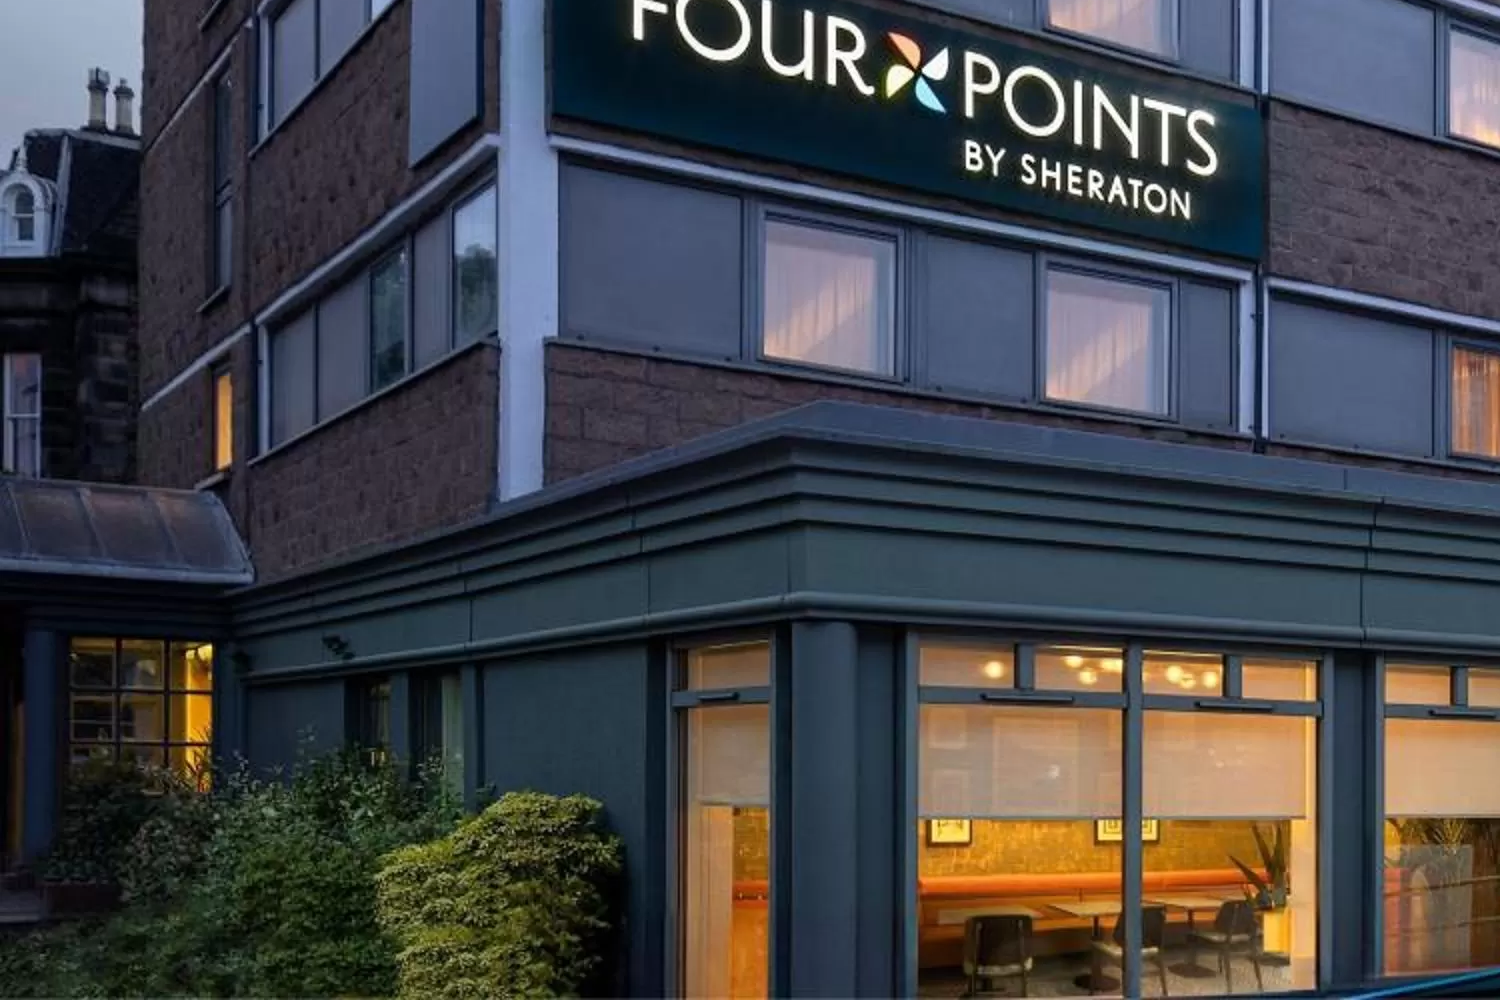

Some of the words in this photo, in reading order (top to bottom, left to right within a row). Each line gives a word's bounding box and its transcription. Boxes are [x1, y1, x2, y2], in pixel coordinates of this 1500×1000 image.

[963, 50, 1220, 178] POINTS
[963, 139, 1008, 178] BY
[1020, 153, 1193, 221] SHERATON
